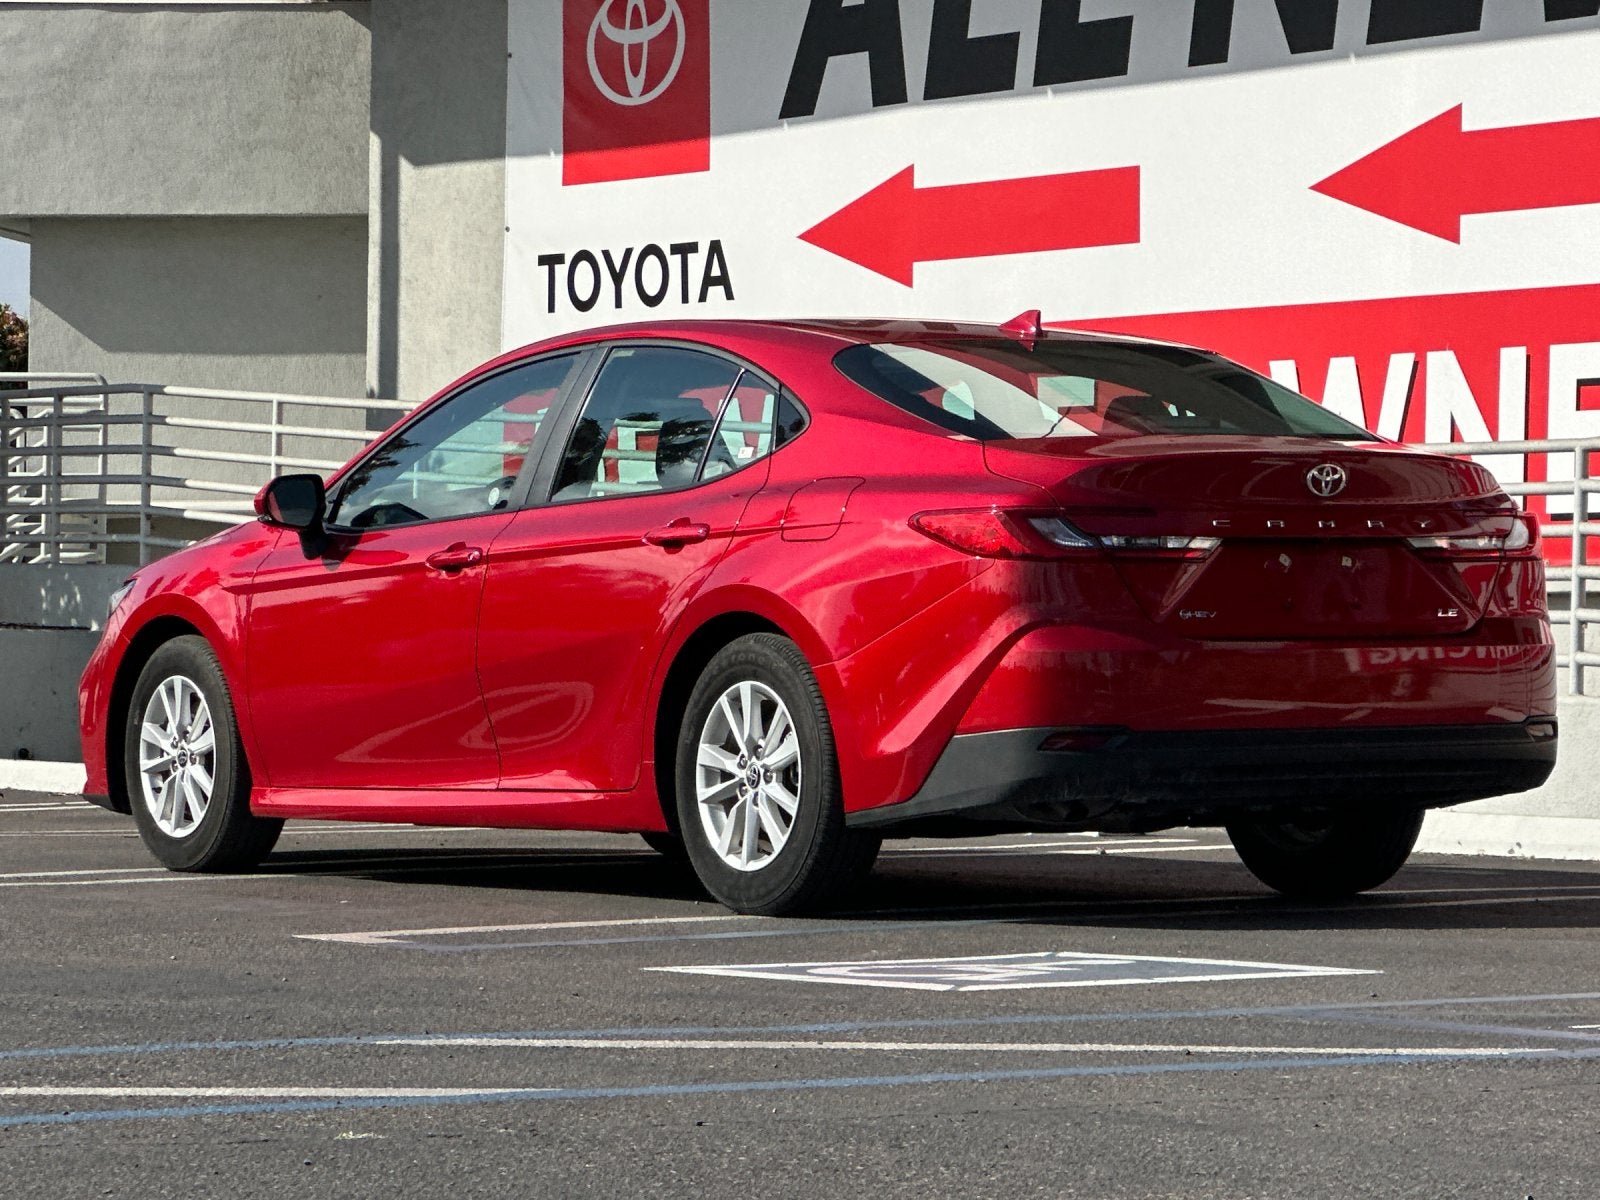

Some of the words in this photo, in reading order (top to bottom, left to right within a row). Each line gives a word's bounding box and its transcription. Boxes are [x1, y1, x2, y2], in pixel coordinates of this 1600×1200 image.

[538, 240, 735, 313] TOYOTA
[1212, 519, 1431, 528] CAMRY
[1437, 608, 1458, 617] LE
